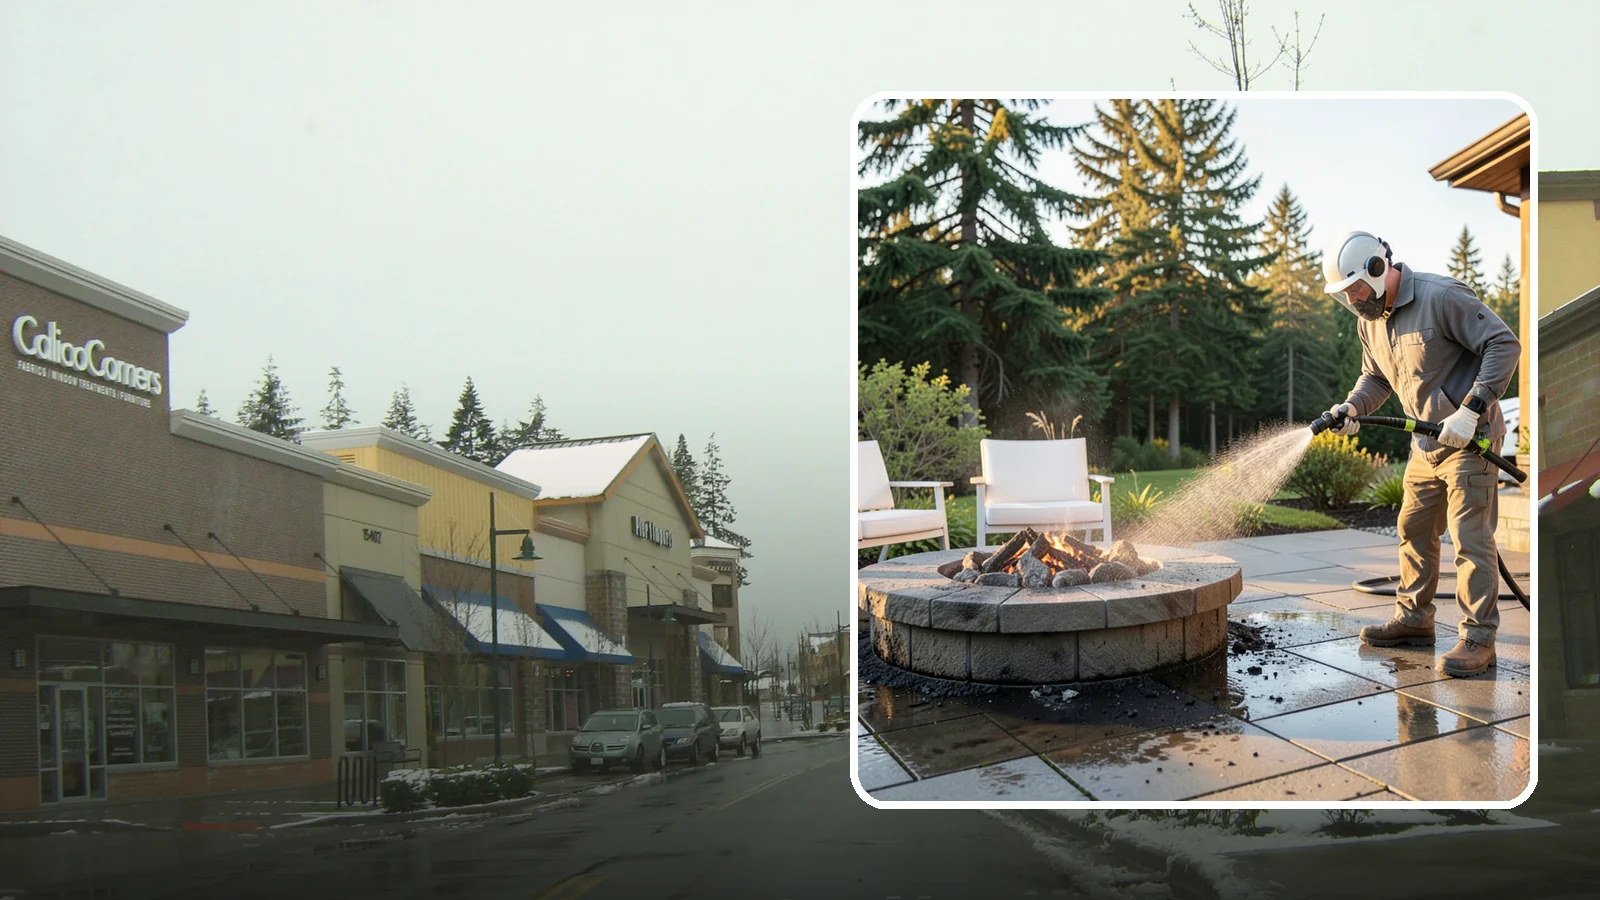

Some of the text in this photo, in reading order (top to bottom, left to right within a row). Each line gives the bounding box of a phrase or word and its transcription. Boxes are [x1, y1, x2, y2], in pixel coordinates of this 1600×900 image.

[16, 360, 151, 408] FABRICS WINDOW TREATMENTS FURNITURE
